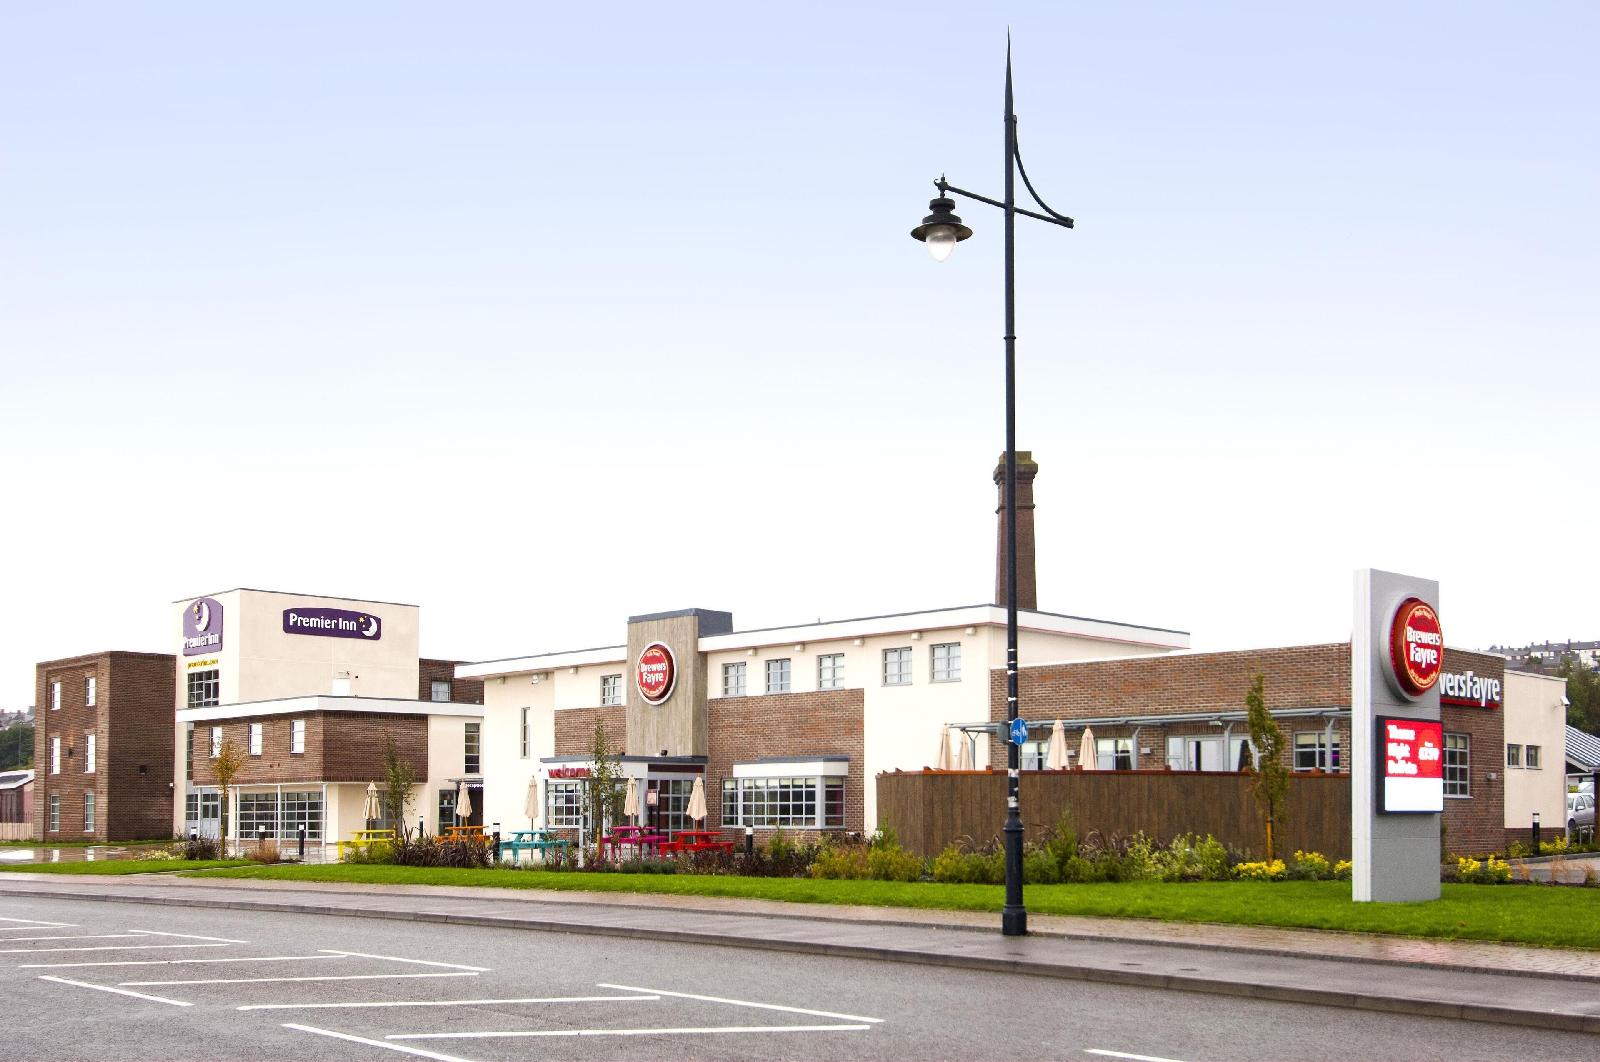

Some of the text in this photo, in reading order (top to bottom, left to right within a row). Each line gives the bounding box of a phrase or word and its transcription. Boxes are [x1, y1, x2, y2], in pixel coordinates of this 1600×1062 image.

[289, 612, 357, 631] Premier Inn
[1406, 626, 1440, 645] Brewers
[1409, 642, 1438, 668] Fayre
[640, 662, 667, 673] Brewers
[642, 672, 664, 686] Fayre
[548, 763, 592, 779] welcome
